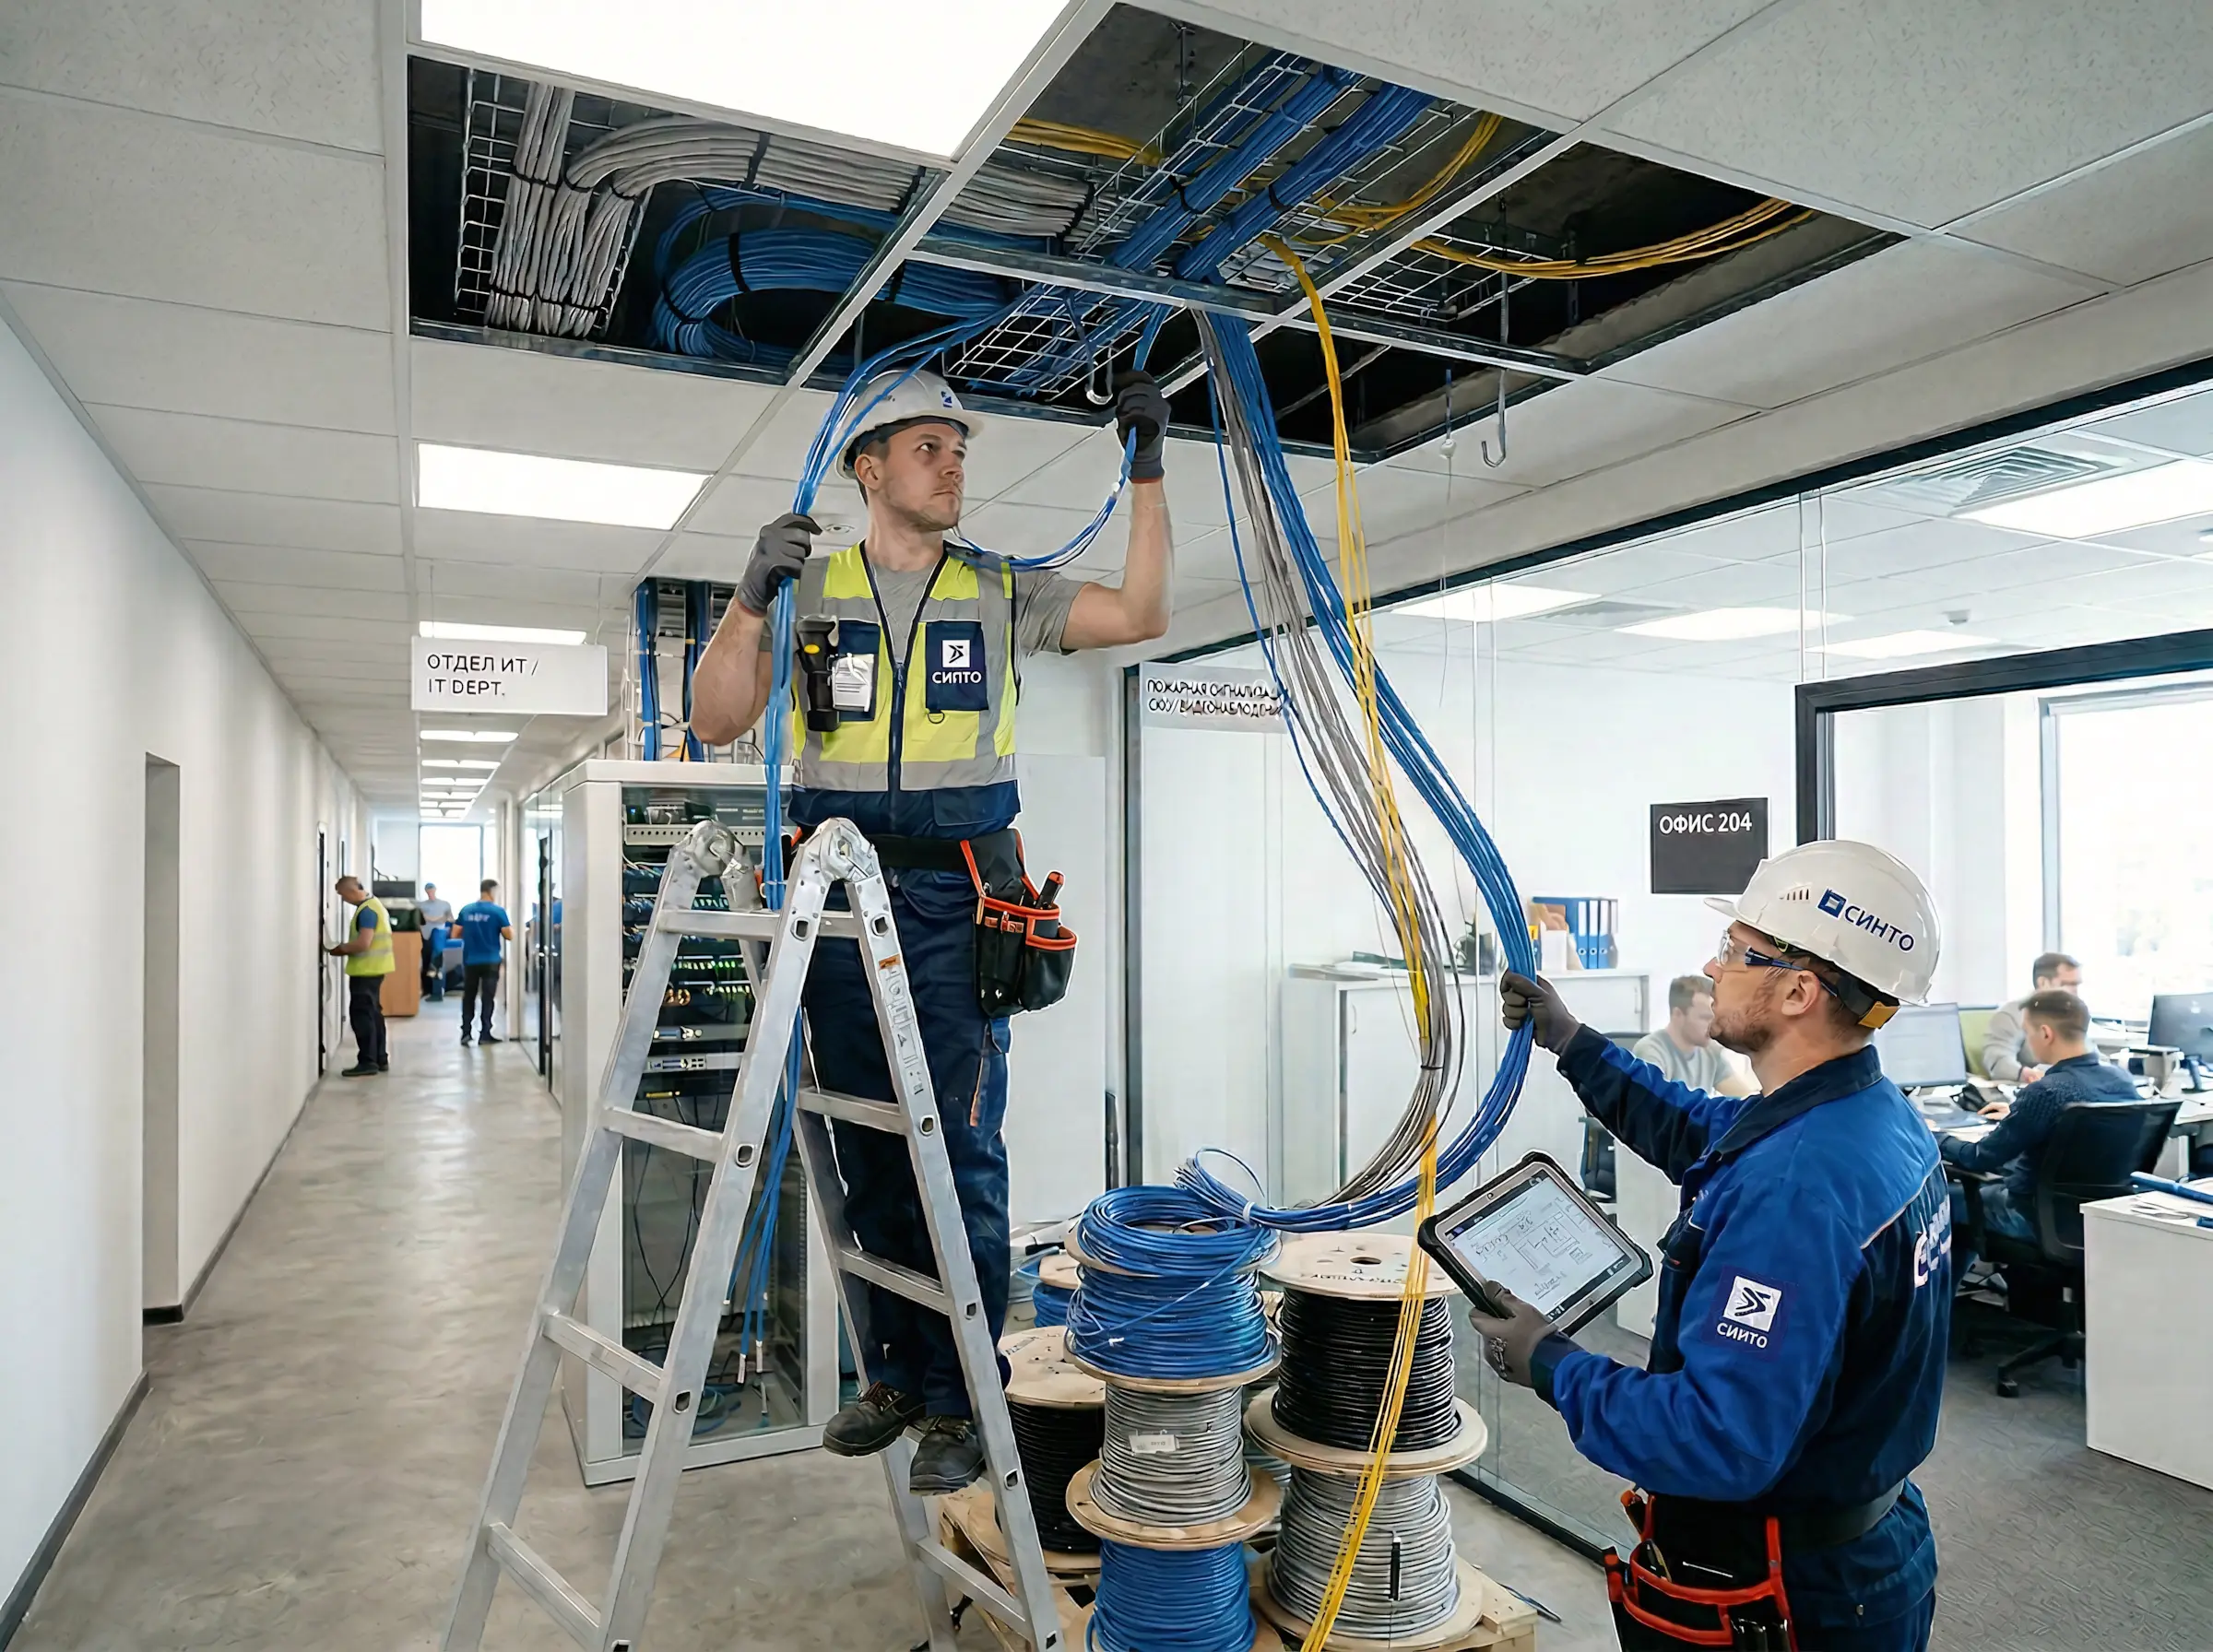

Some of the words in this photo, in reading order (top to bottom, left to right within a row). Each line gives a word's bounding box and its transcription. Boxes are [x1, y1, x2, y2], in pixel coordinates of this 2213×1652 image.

[427, 654, 495, 674] ОТДЕЛ
[501, 658, 527, 674] ИТ
[429, 678, 446, 693] IT
[452, 678, 505, 696] DEPT.
[1659, 813, 1714, 834] ОФИС
[1718, 812, 1753, 832] 204
[1844, 905, 1914, 952] СИНТО
